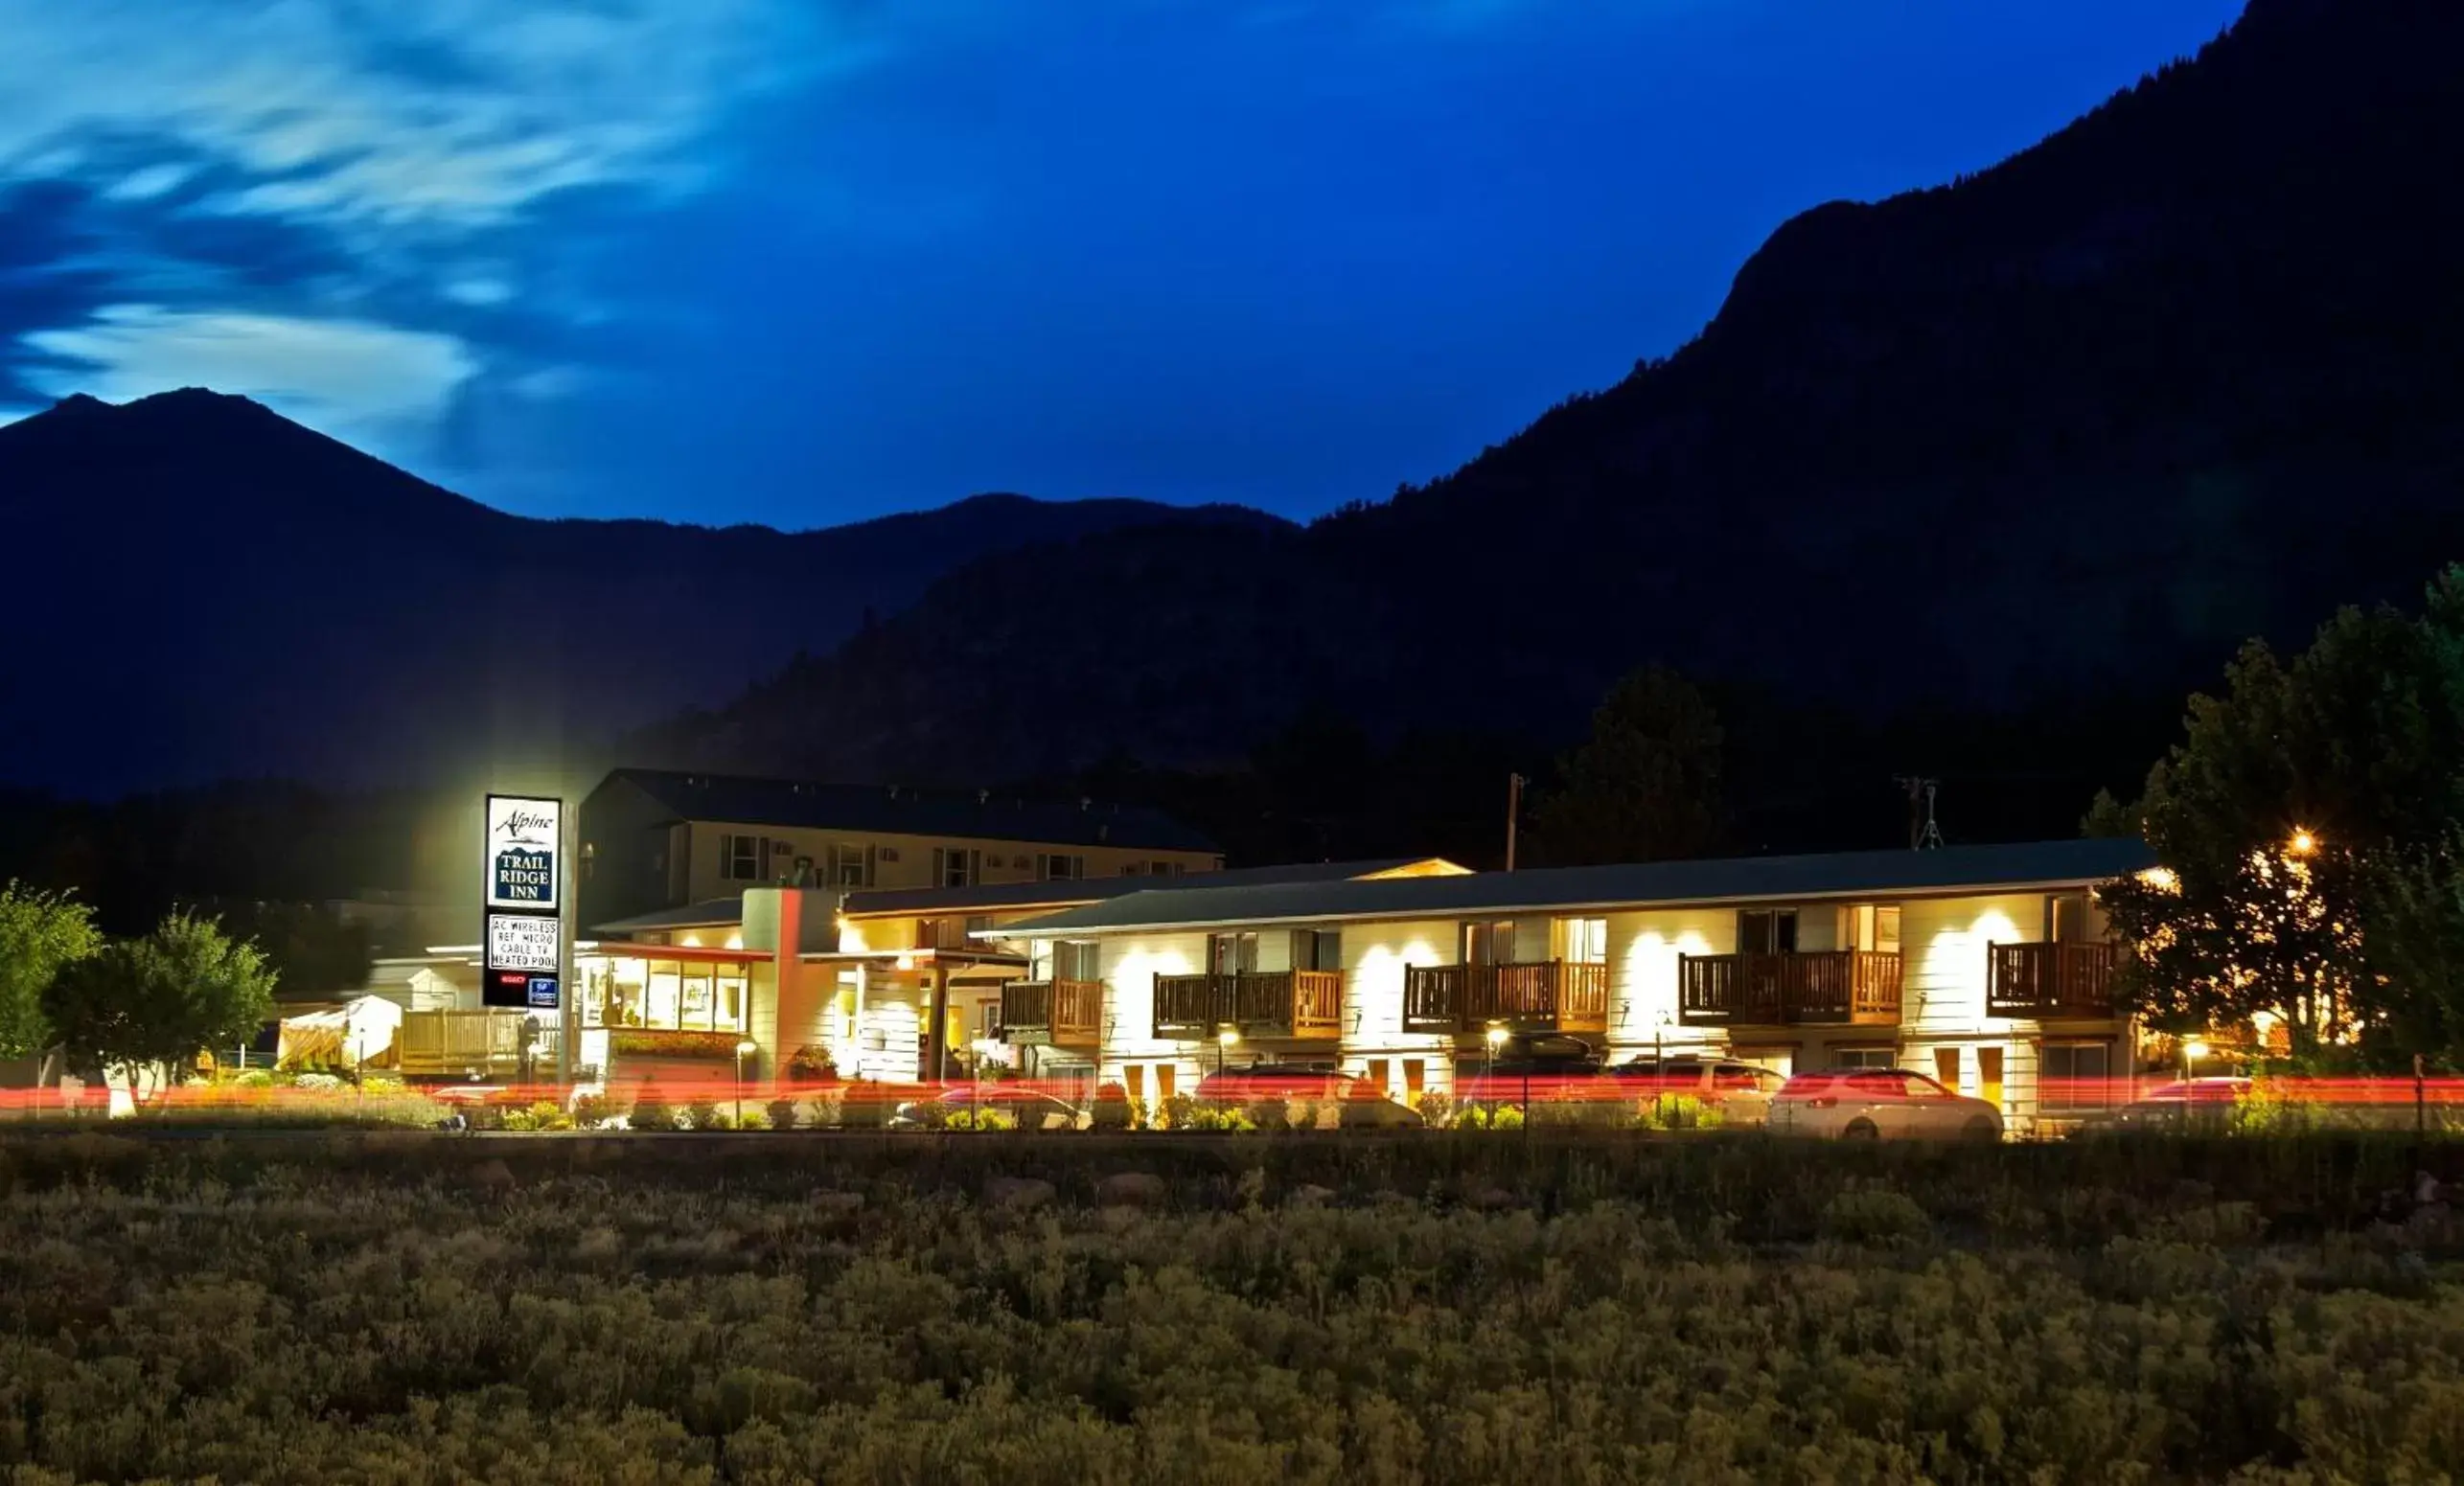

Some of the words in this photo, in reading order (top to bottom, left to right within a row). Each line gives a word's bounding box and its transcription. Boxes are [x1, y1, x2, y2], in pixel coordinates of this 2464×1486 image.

[495, 810, 554, 837] Alpine
[501, 855, 547, 870] TRAIL
[500, 870, 549, 884] RIDGE
[510, 884, 538, 899] INN
[494, 921, 507, 930] AC
[511, 922, 556, 933] WIRELESS
[522, 934, 553, 945] MICRO
[501, 944, 531, 954] CABLE
[537, 946, 547, 954] TV
[492, 954, 528, 966] HEATED
[532, 957, 557, 967] POOL
